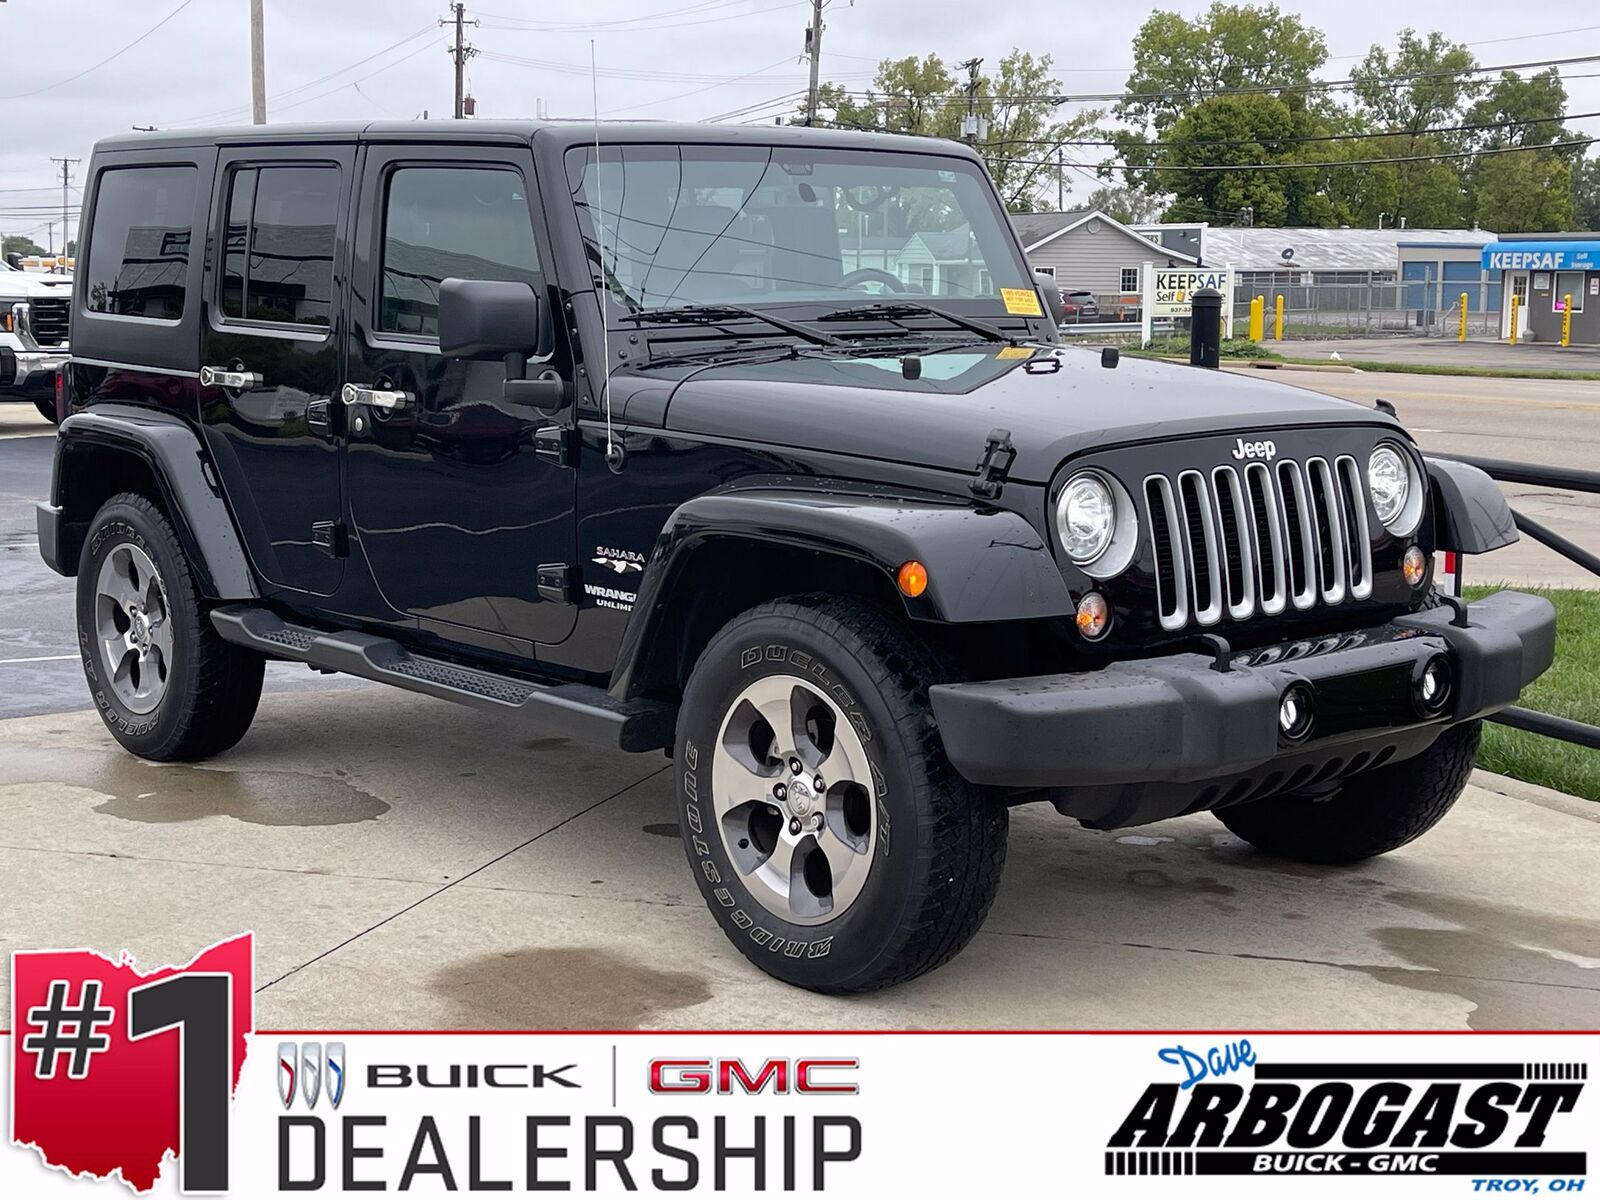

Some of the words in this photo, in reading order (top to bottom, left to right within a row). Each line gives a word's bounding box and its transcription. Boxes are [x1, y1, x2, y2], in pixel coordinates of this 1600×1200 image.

[1490, 252, 1564, 269] KEEPSAF
[1156, 274, 1227, 289] KEEPSAF
[1156, 291, 1175, 302] Self
[1232, 438, 1276, 461] Jeep
[596, 546, 645, 563] SAHARA
[740, 644, 872, 743] DUELER
[685, 739, 834, 960] BRIDGESTONE
